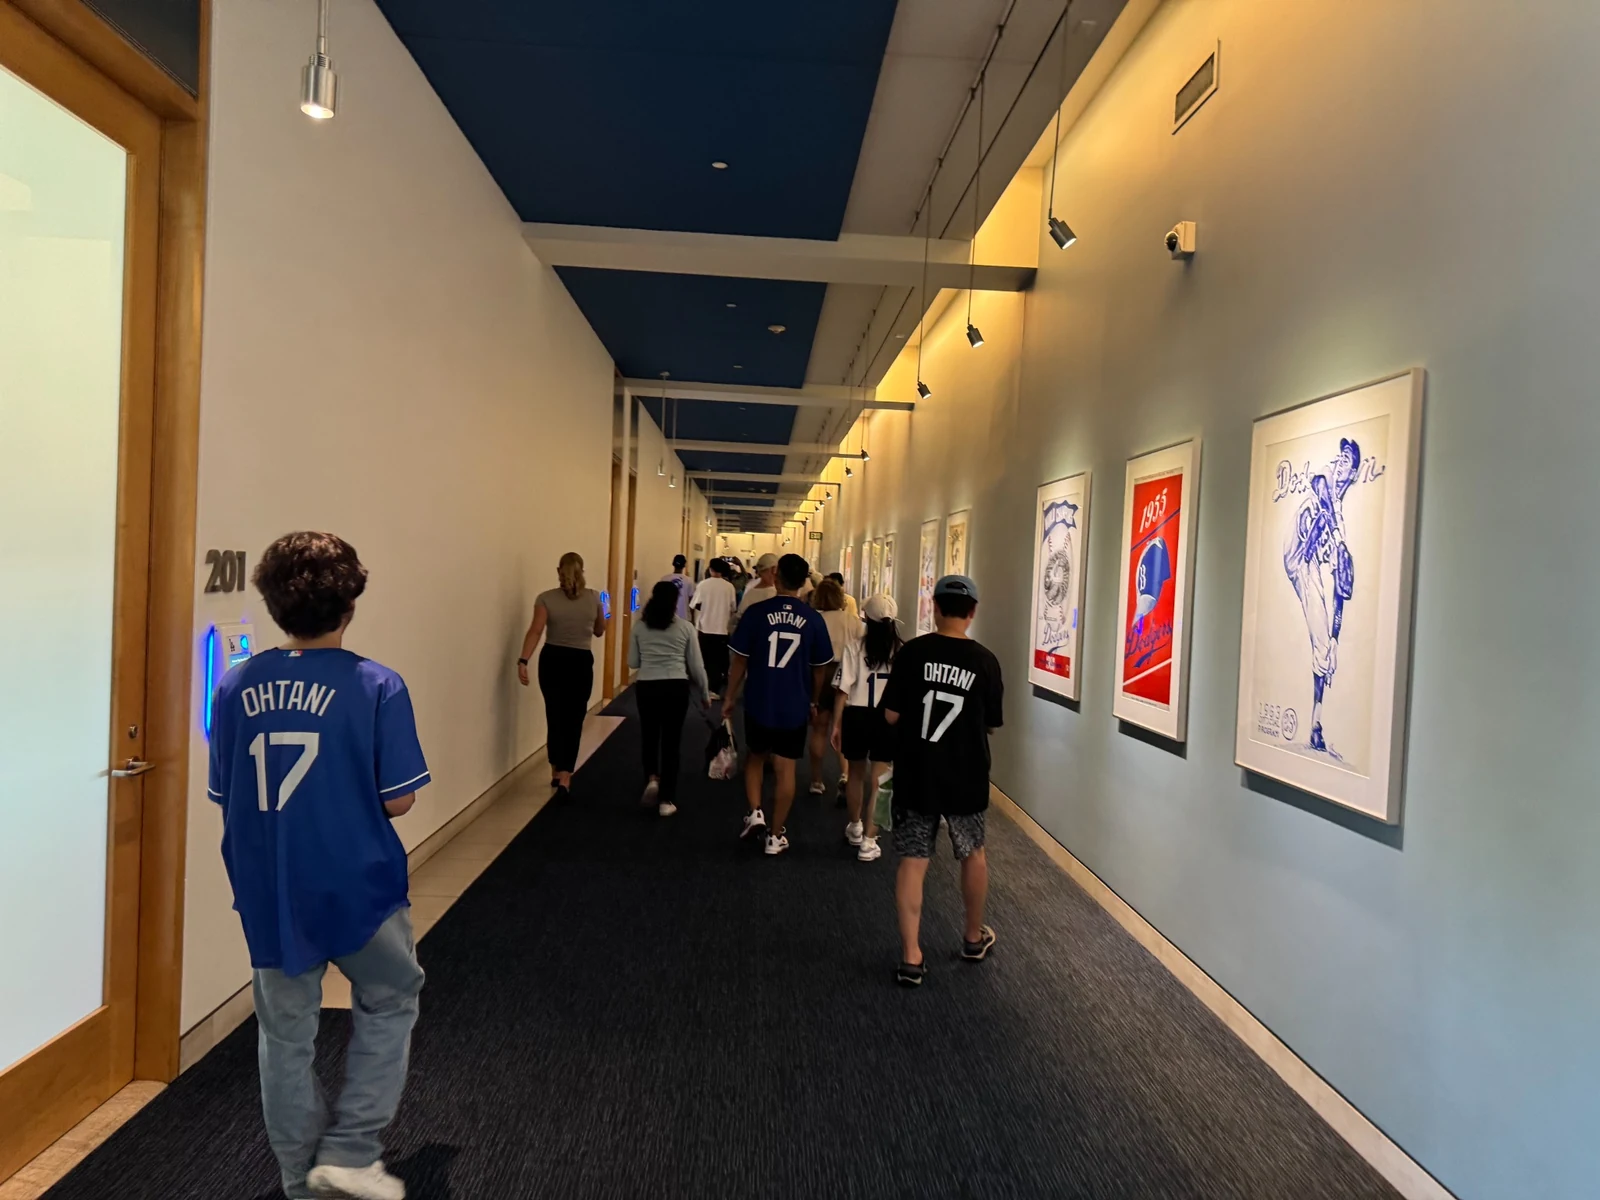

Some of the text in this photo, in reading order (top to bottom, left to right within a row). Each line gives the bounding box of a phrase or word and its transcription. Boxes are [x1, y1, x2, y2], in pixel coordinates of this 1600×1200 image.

[1139, 488, 1168, 533] 1955
[204, 549, 246, 593] 201
[767, 611, 807, 629] OHTANI
[768, 631, 802, 669] 17
[924, 662, 976, 691] OHTANI
[241, 680, 336, 717] OHTANI
[921, 690, 965, 742] 17
[248, 732, 320, 812] 17
